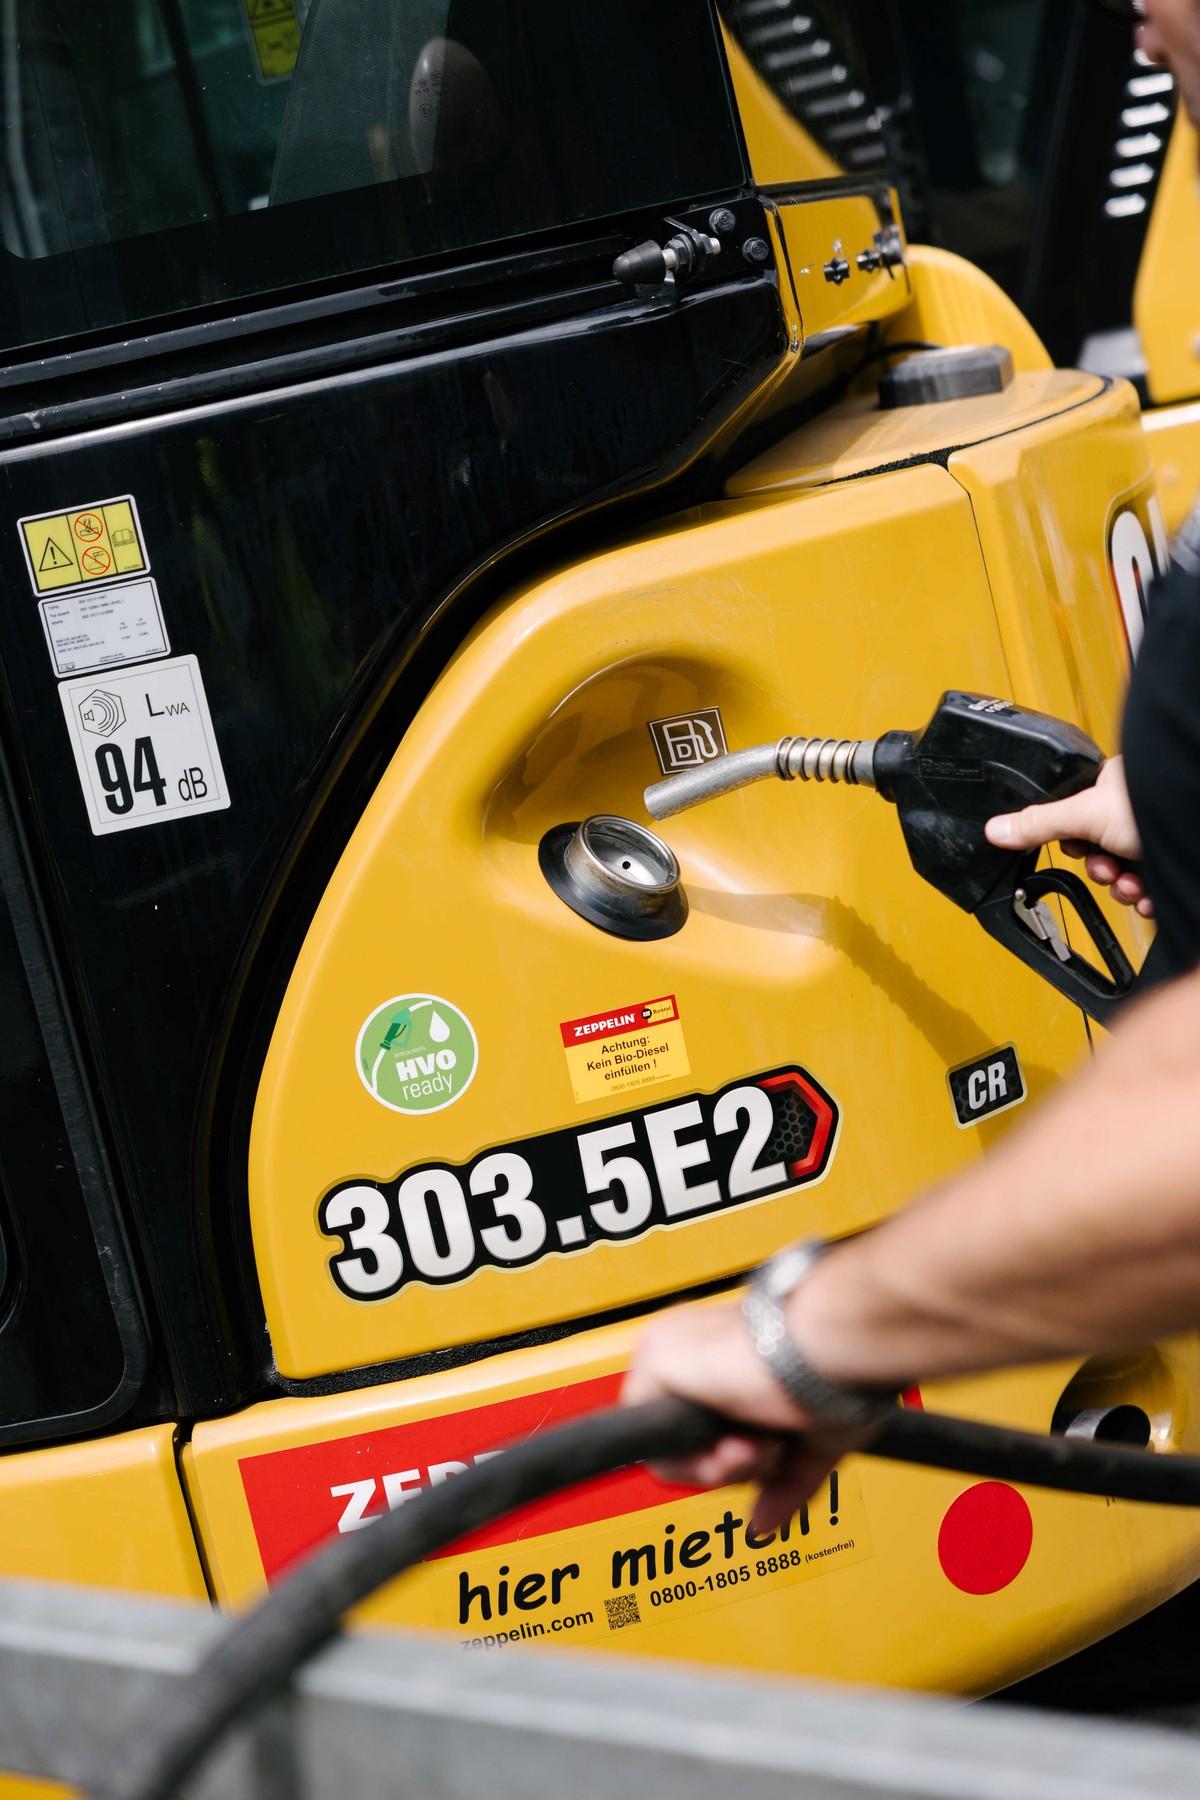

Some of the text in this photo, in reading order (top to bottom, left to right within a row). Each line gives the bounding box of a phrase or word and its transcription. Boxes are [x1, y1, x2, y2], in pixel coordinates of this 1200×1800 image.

[676, 743, 693, 759] D
[95, 736, 208, 815] 94 dB
[574, 1013, 635, 1037] ZEPPELIN
[587, 1042, 669, 1072] Kein Bio-Diesel
[601, 1035, 651, 1055] Achtung:
[395, 1049, 457, 1083] HVO
[604, 1061, 651, 1081] einfüllen
[402, 1071, 453, 1101] ready
[967, 1061, 1008, 1110] CR
[325, 1085, 788, 1294] 303.5E2
[459, 1563, 580, 1625] hier
[829, 1470, 839, 1526] !
[650, 1539, 855, 1607] 0800-1805 8888 (kostenfrei)
[460, 1611, 594, 1652] zeppelin.com
